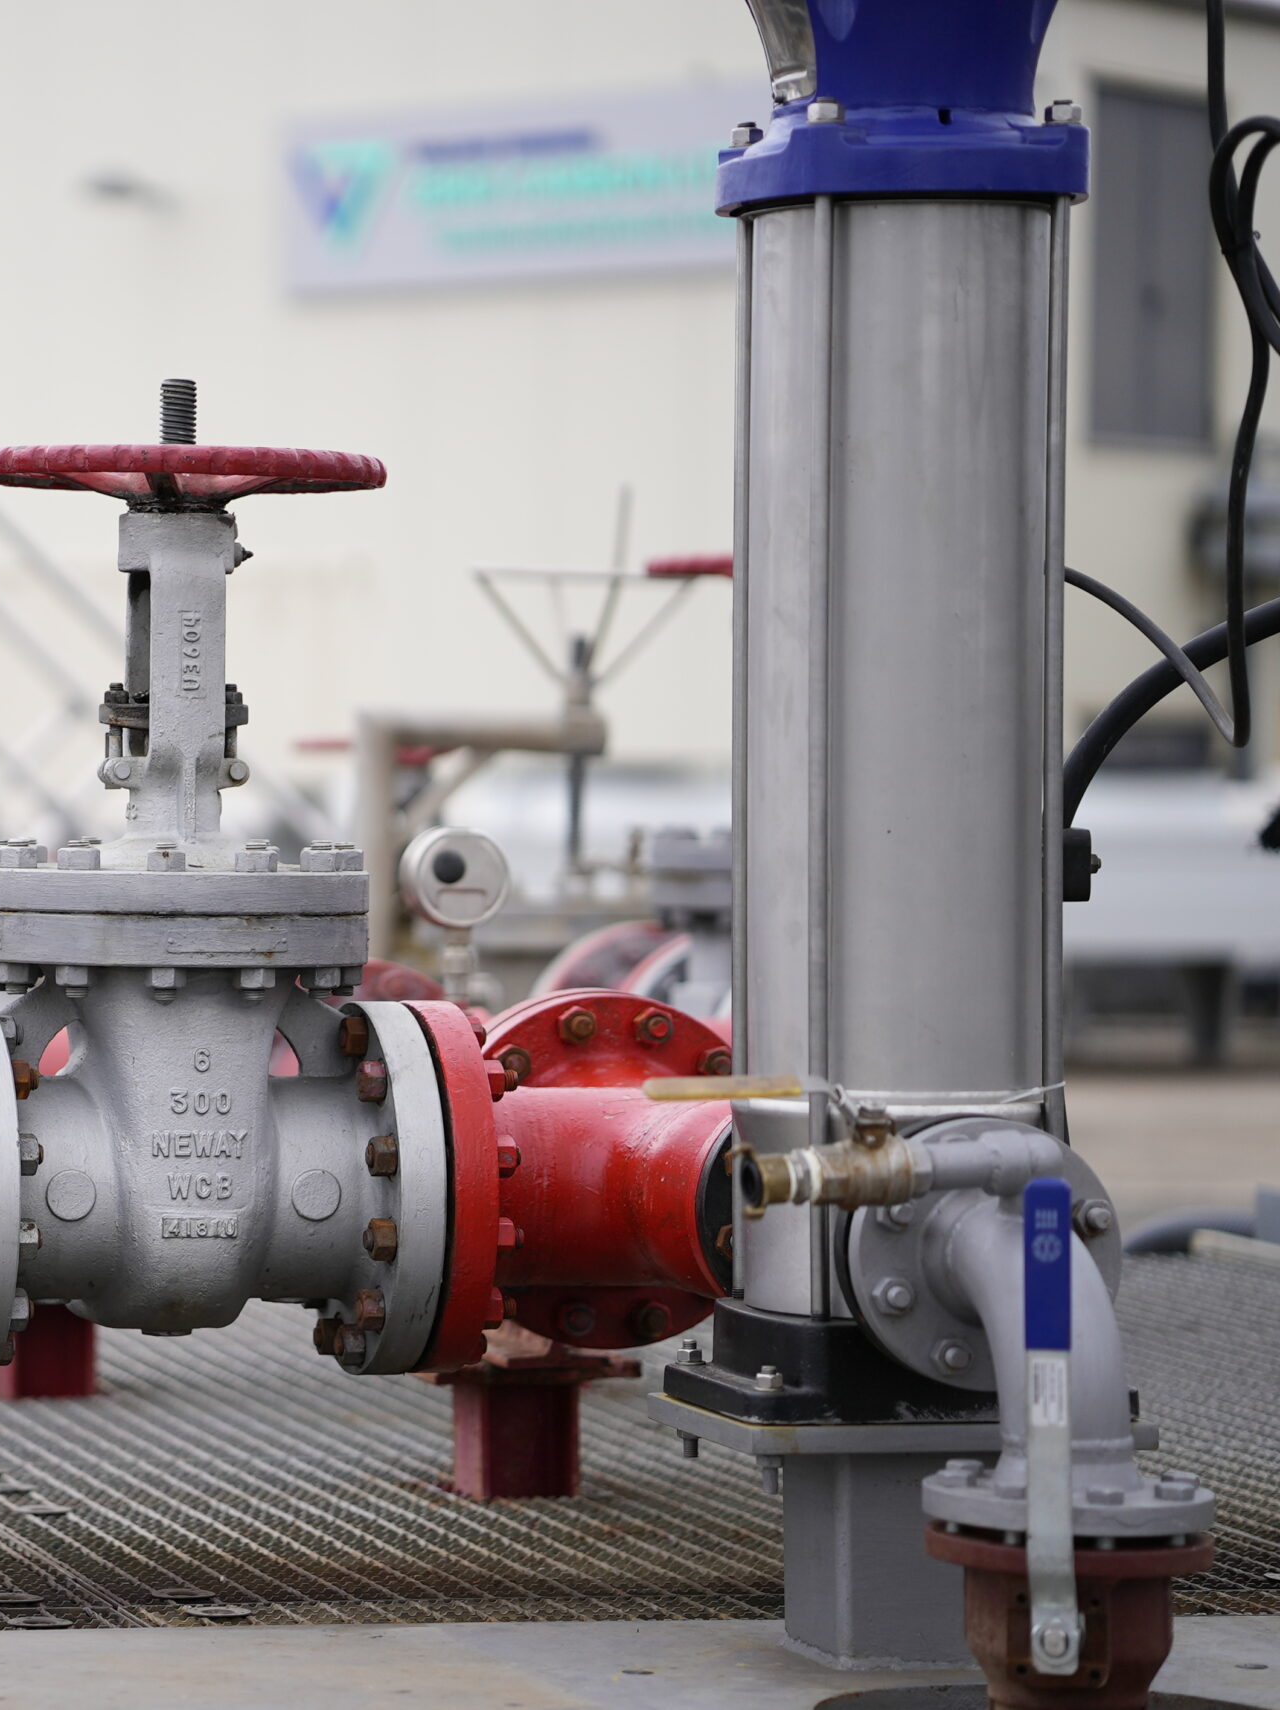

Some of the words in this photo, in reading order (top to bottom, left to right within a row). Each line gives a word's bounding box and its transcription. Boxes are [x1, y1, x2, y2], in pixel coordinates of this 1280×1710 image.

[182, 616, 201, 692] U3604
[193, 1047, 211, 1073] 6
[169, 1087, 232, 1116] 300
[151, 1129, 248, 1159] NEWAY
[167, 1172, 233, 1200] WCB
